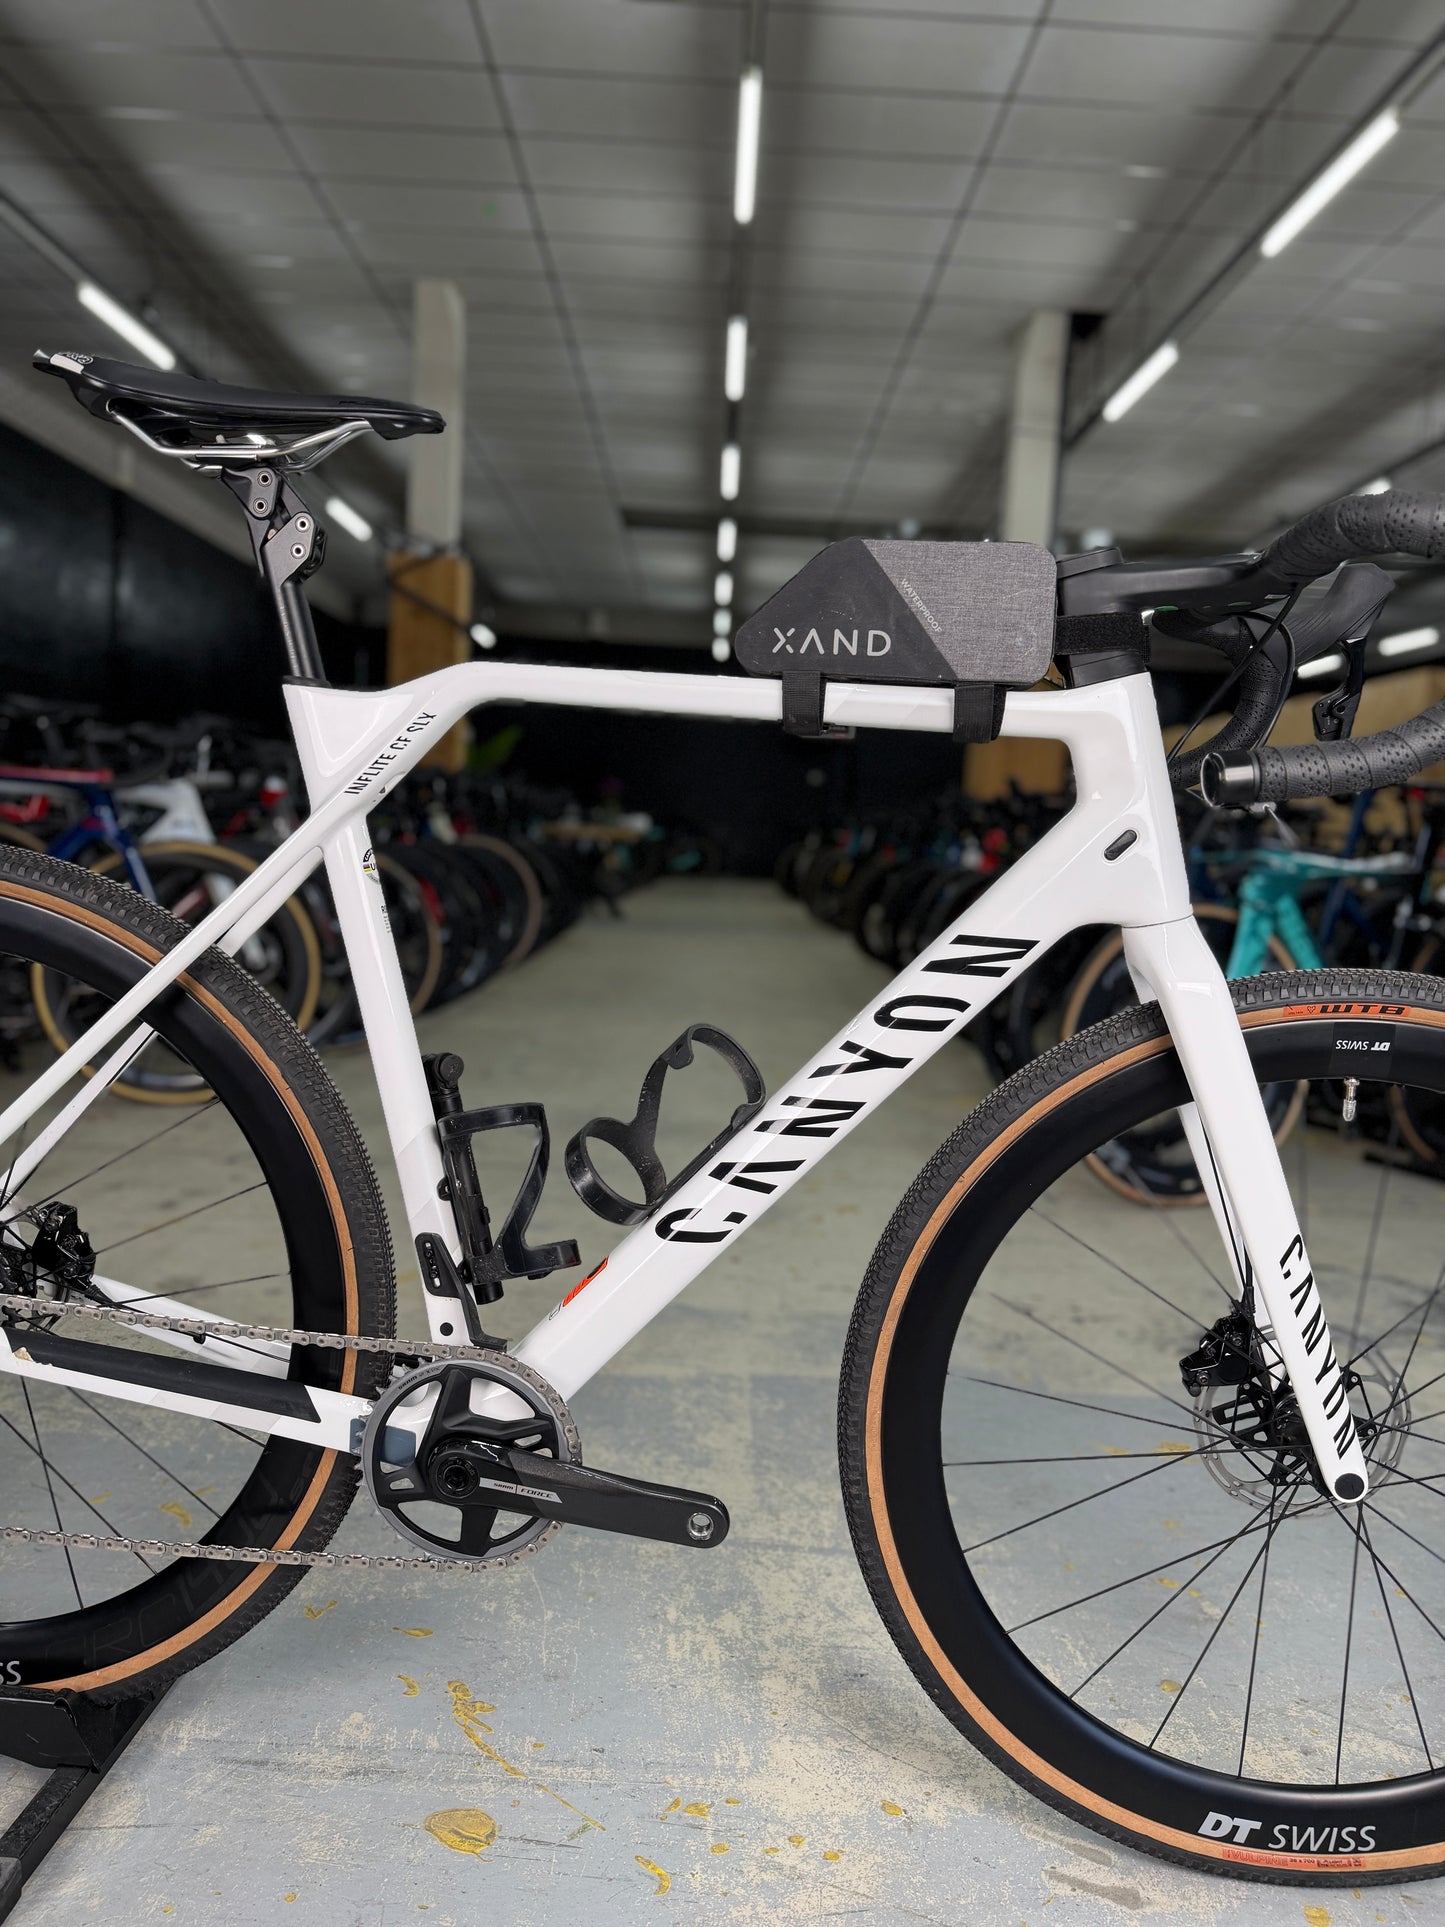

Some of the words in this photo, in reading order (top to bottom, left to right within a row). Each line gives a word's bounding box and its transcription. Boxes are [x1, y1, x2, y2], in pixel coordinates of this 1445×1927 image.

[901, 578, 942, 632] WATERPROOF
[772, 627, 892, 656] XAND
[343, 753, 397, 795] INFLITE
[389, 736, 412, 750] CF
[406, 712, 437, 733] SLX
[1319, 1004, 1405, 1015] WTB
[1335, 1039, 1370, 1051] SWISS
[1370, 1041, 1391, 1051] DT
[655, 934, 1041, 1243] CANYON
[1279, 1233, 1356, 1460] CANYON
[520, 1488, 555, 1499] FORCE
[1198, 1811, 1262, 1844] DT
[1268, 1824, 1376, 1853] SWISS
